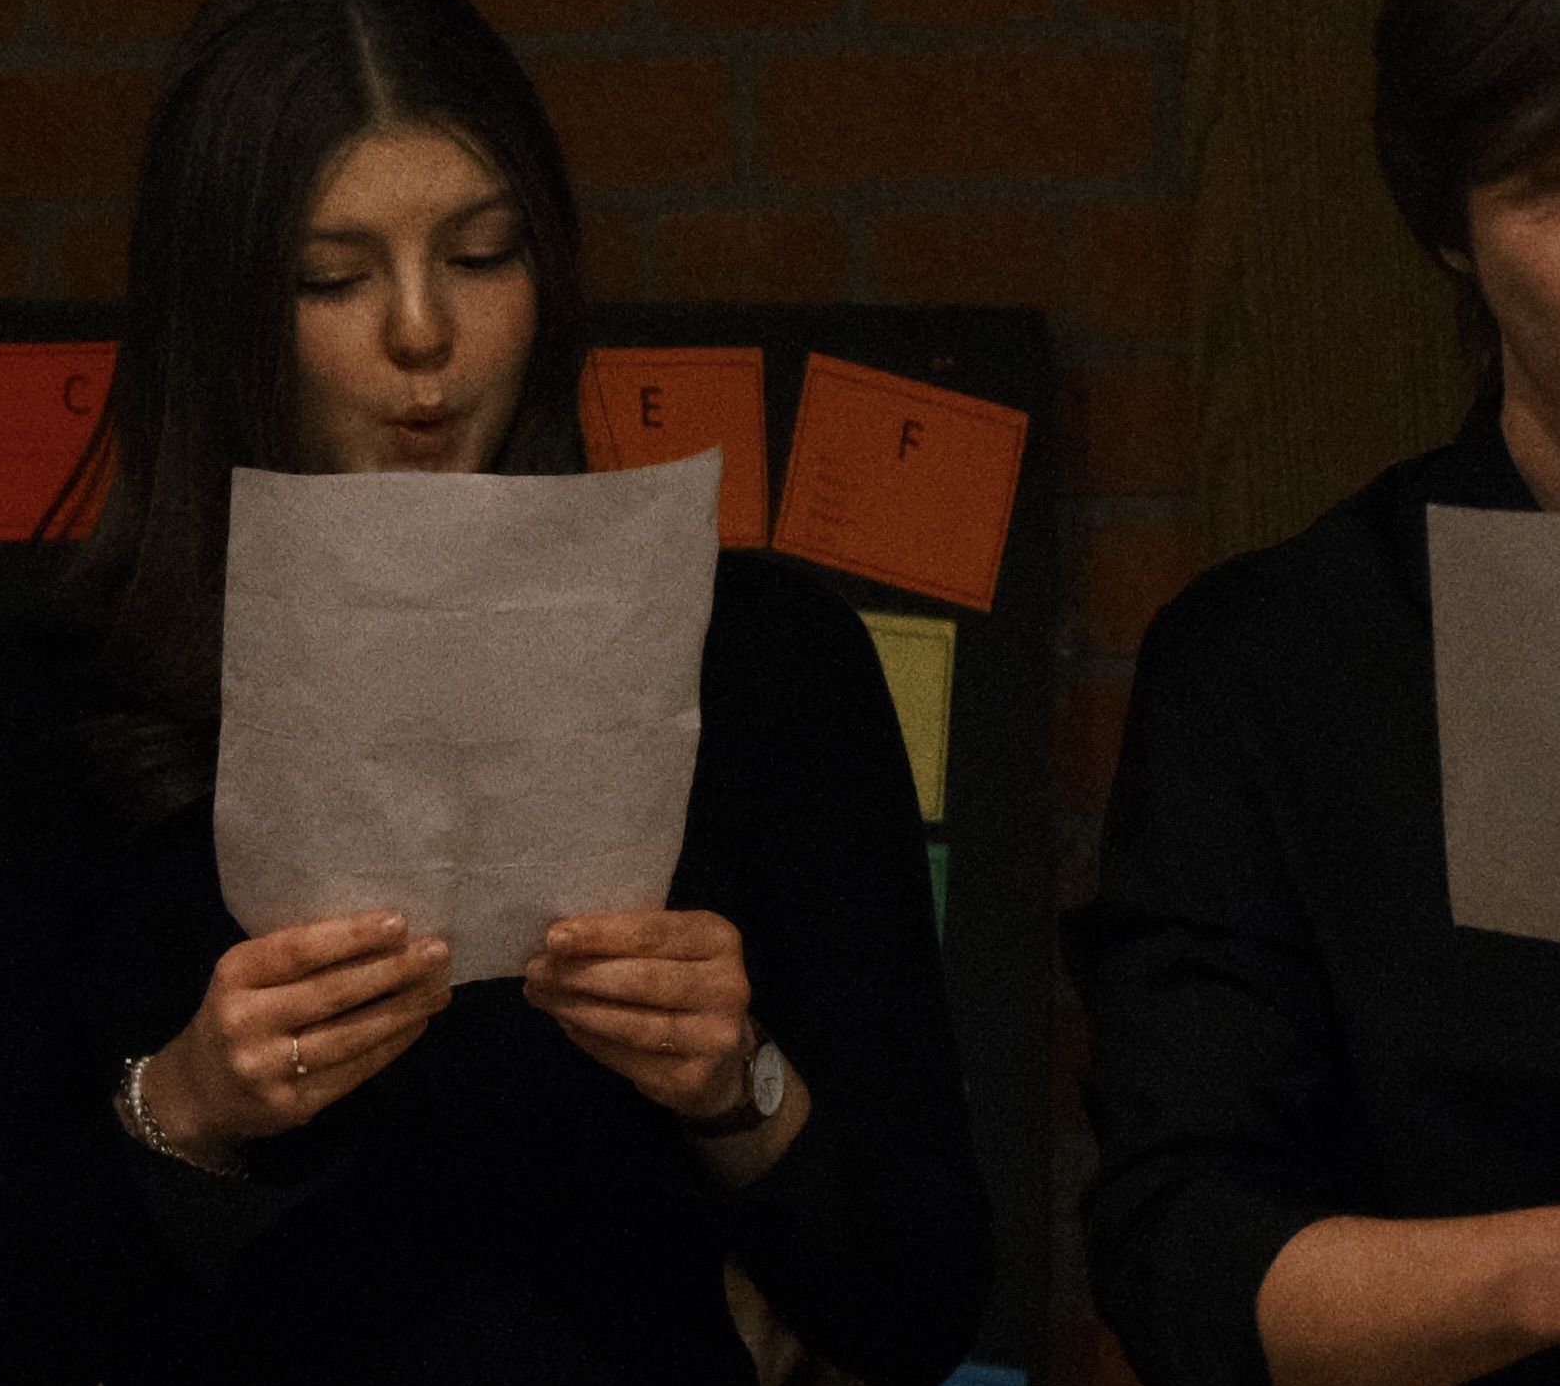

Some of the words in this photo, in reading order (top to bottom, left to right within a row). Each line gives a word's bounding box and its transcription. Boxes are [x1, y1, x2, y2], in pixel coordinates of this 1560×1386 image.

[61, 373, 91, 415] C
[639, 385, 664, 430] E
[897, 418, 925, 462] F
